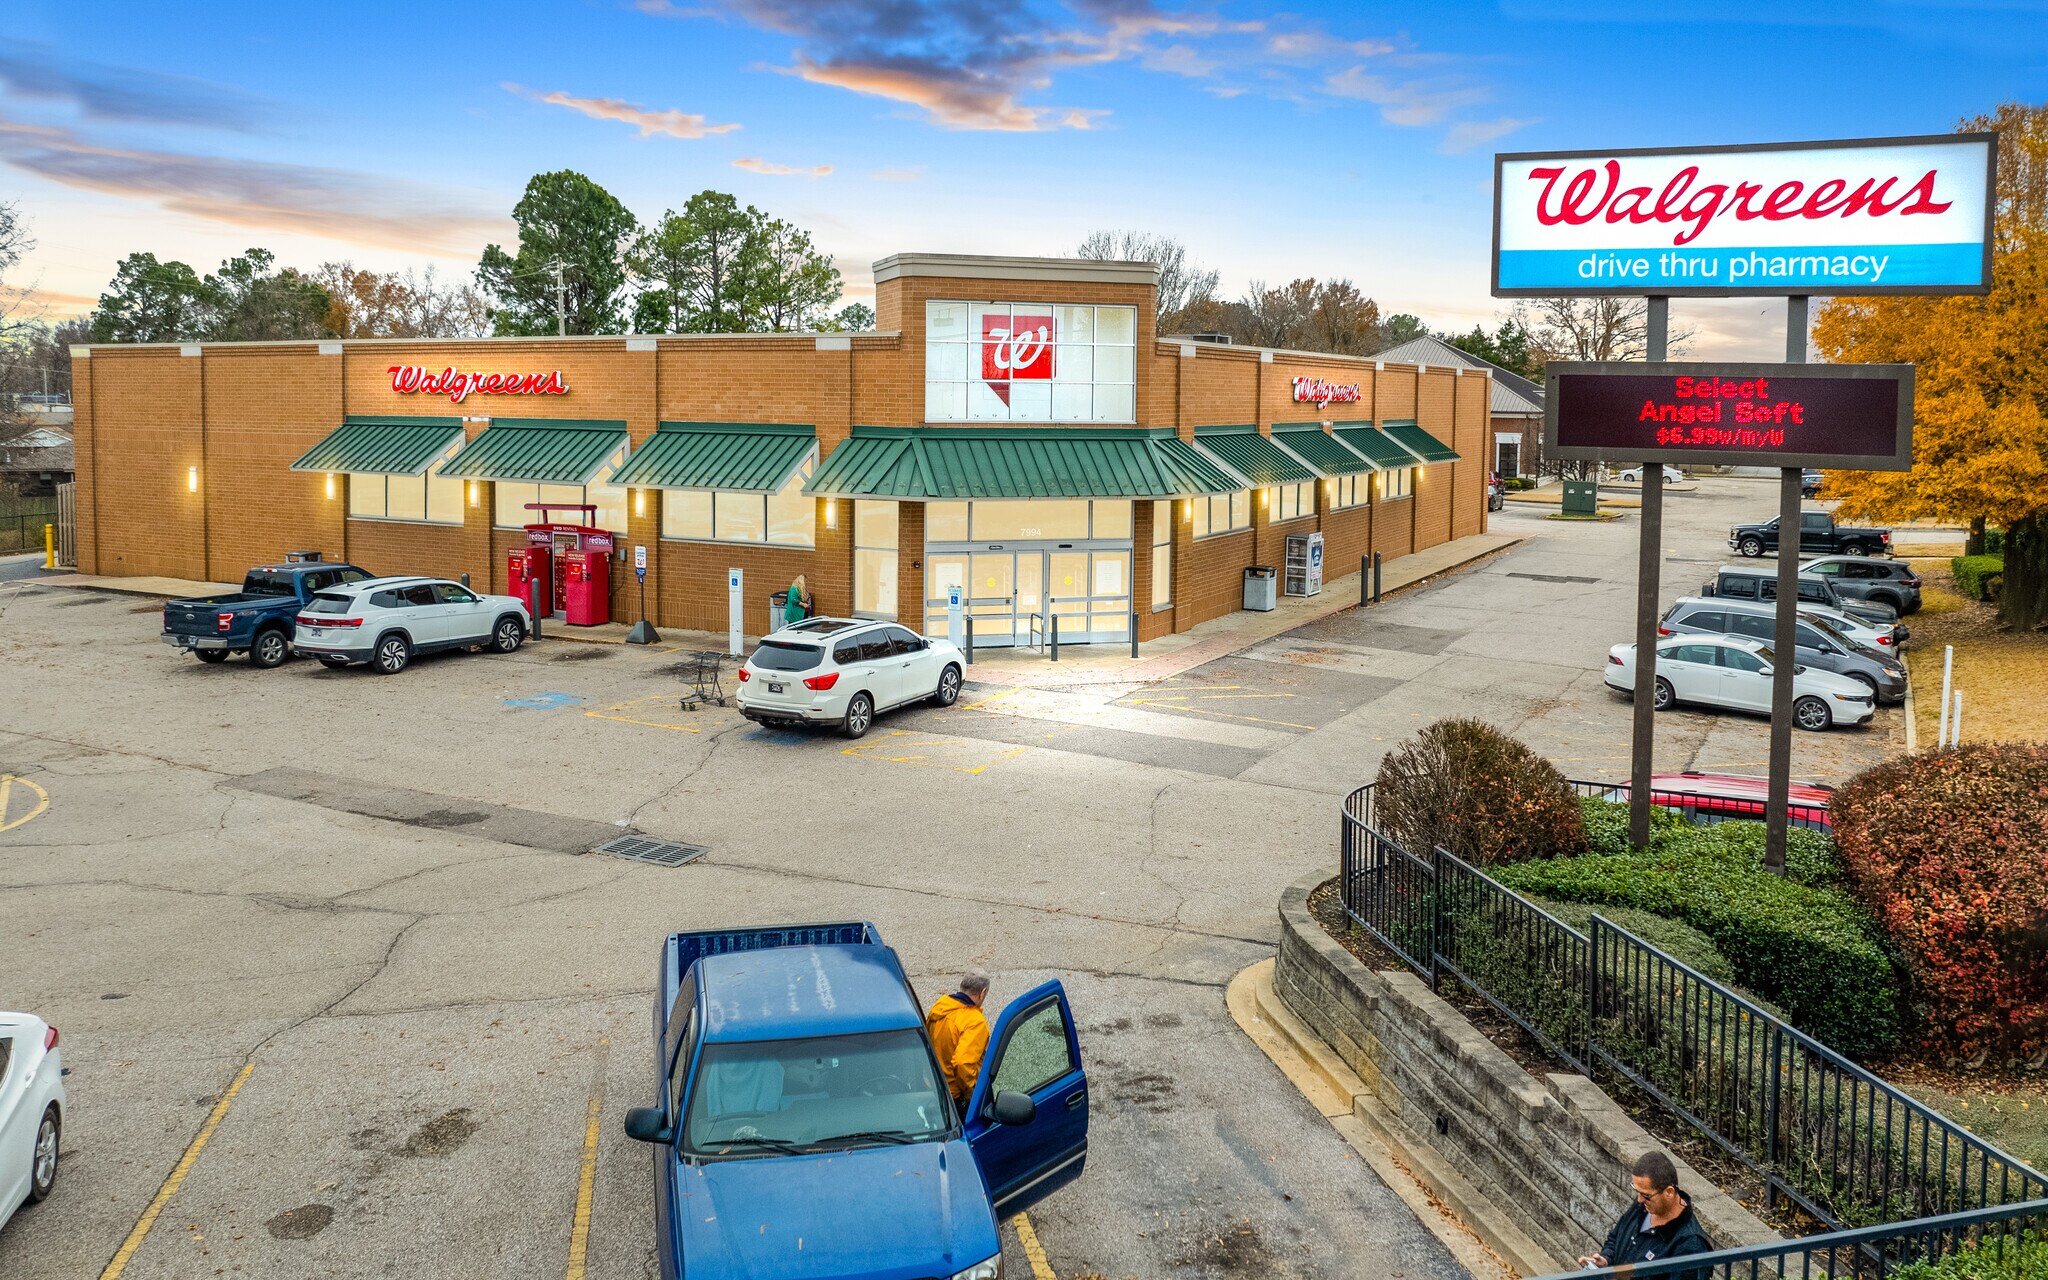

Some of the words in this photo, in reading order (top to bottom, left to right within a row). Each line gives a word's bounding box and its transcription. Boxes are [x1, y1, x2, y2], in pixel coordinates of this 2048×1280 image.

[1527, 159, 1953, 246] Walgreens
[1578, 253, 1649, 278] drive
[1659, 251, 1718, 277] thru
[1729, 251, 1889, 282] pharmacy
[387, 364, 570, 403] Walgreens
[1292, 377, 1362, 410] Walgreens
[1675, 376, 1769, 399] Select
[1638, 400, 1723, 425] Angel
[1734, 401, 1804, 425] Soft
[528, 532, 549, 541] redbox
[588, 537, 610, 545] redbox
[1020, 528, 1042, 537] 7994
